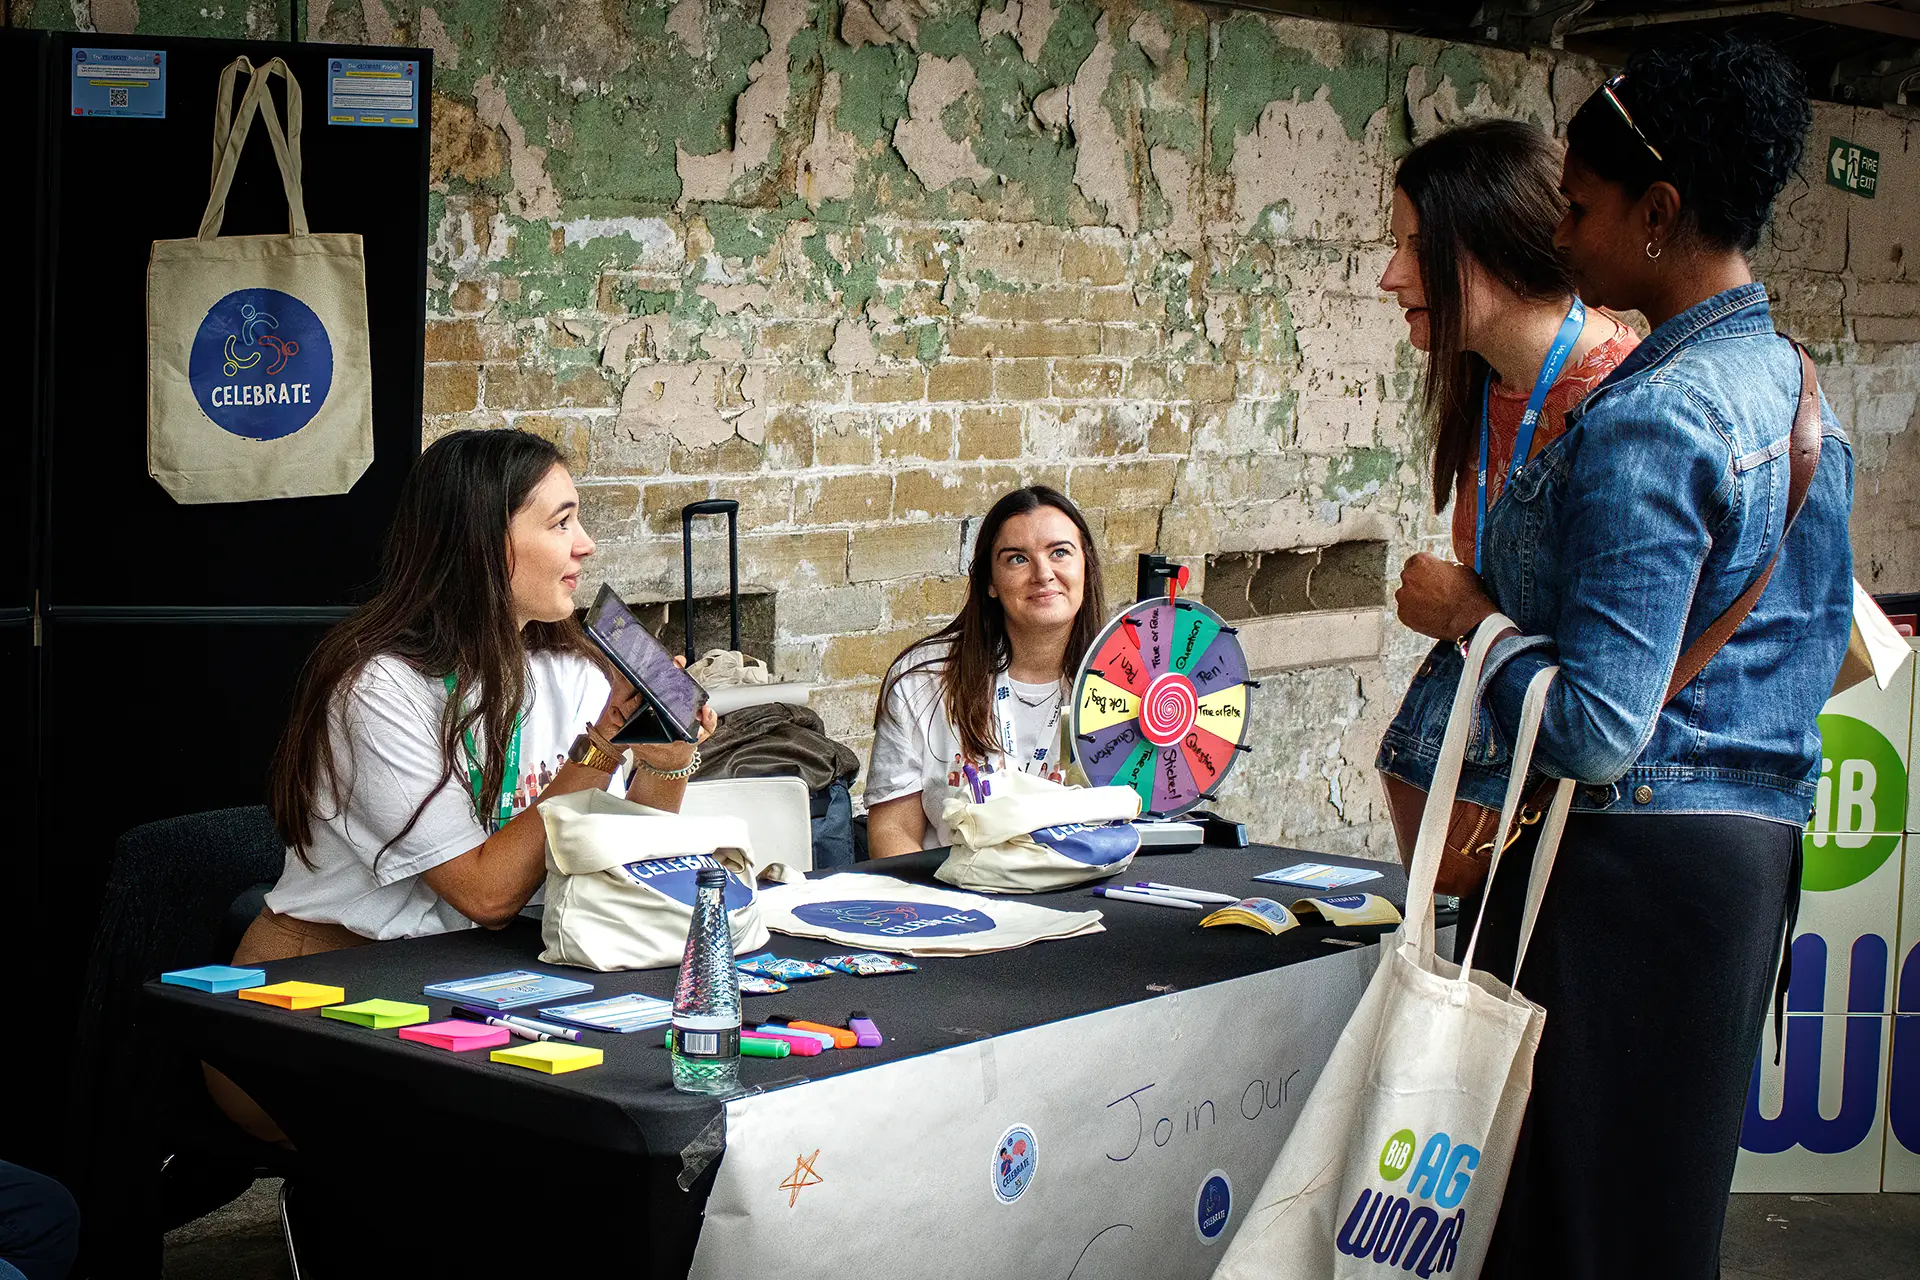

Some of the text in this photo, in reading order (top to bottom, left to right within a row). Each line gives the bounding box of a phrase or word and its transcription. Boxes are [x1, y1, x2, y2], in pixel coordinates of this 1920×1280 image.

[1861, 156, 1878, 173] FIRE
[1859, 174, 1876, 190] EXIT
[211, 382, 311, 408] CELEBRATE
[1151, 629, 1159, 642] or
[1175, 619, 1203, 670] Question
[1151, 645, 1161, 669] True
[1197, 703, 1242, 718] True or False
[1089, 728, 1135, 765] Question
[1185, 733, 1216, 777] Question
[1162, 748, 1182, 801] Sticker!
[1813, 757, 1877, 849] iB
[1106, 1082, 1216, 1162] Join
[1384, 1139, 1411, 1170] BiB
[1002, 1157, 1030, 1188] CELEBRATE
[1203, 1209, 1226, 1230] CELEBRATE
